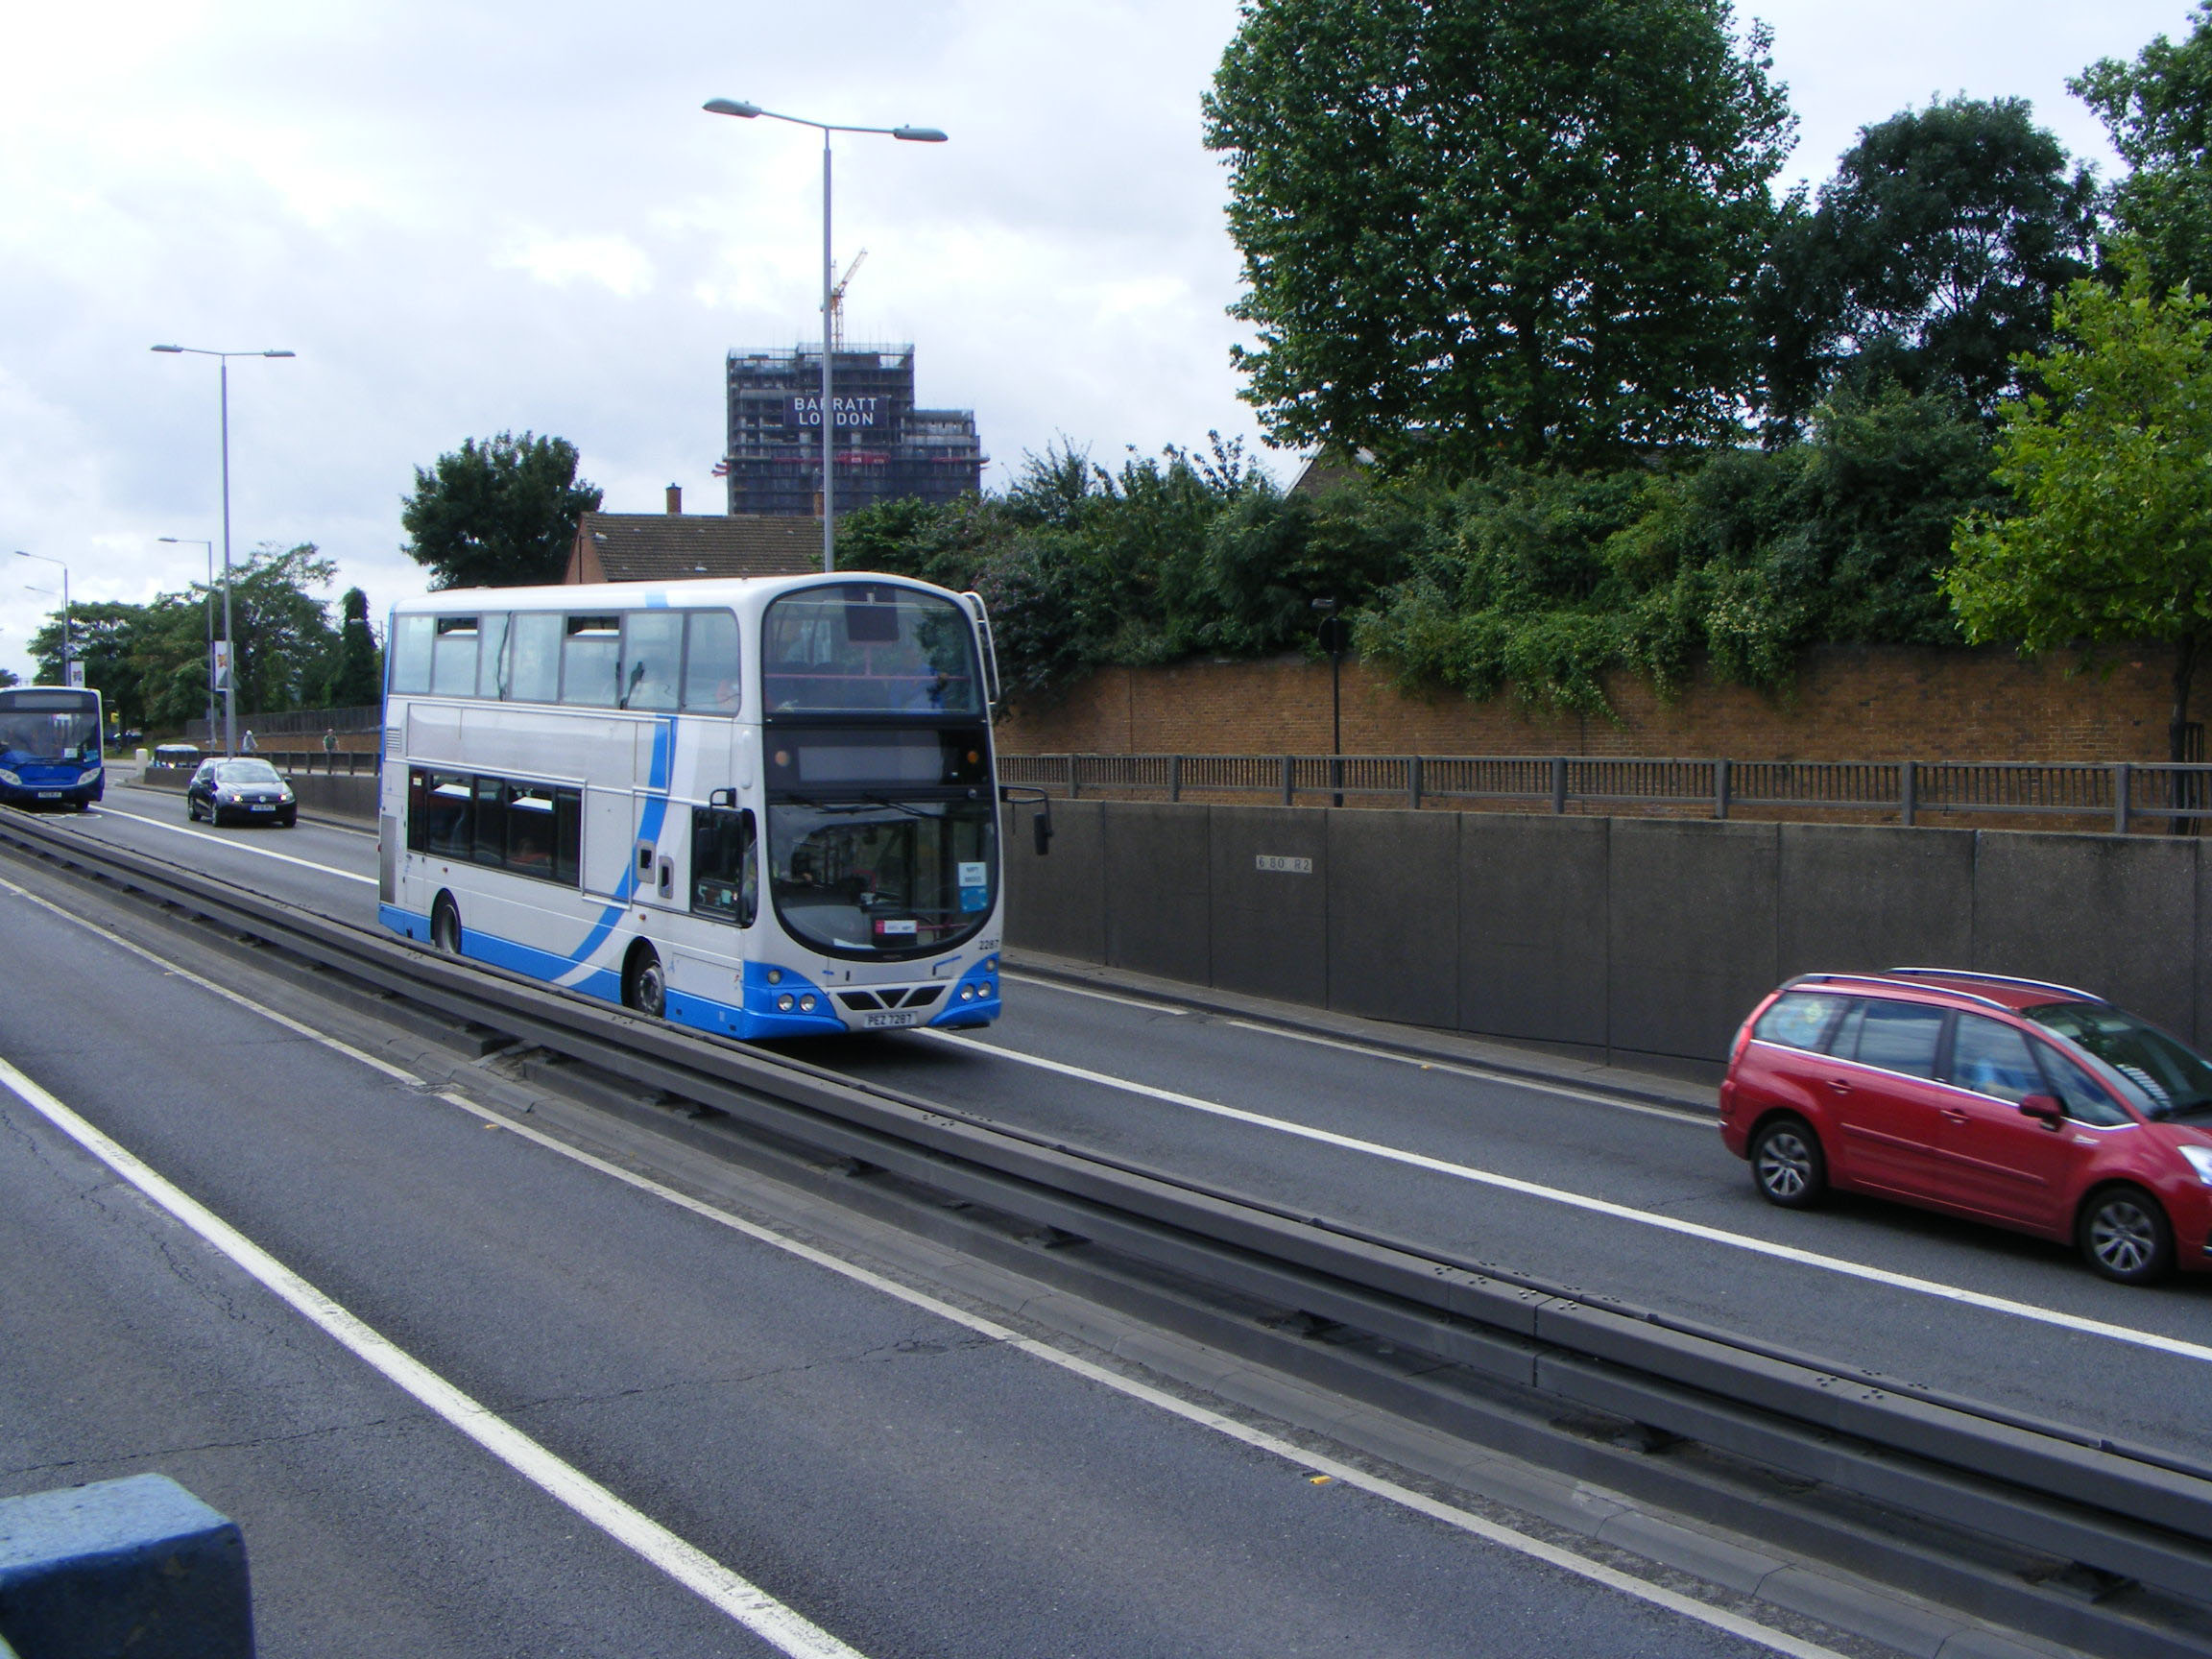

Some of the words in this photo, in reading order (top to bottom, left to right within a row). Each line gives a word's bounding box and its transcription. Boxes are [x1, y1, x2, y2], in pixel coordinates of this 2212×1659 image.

[799, 412, 874, 425] LODON
[978, 939, 999, 950] 2287
[868, 1014, 886, 1025] PEZ
[889, 1013, 912, 1024] 7287
